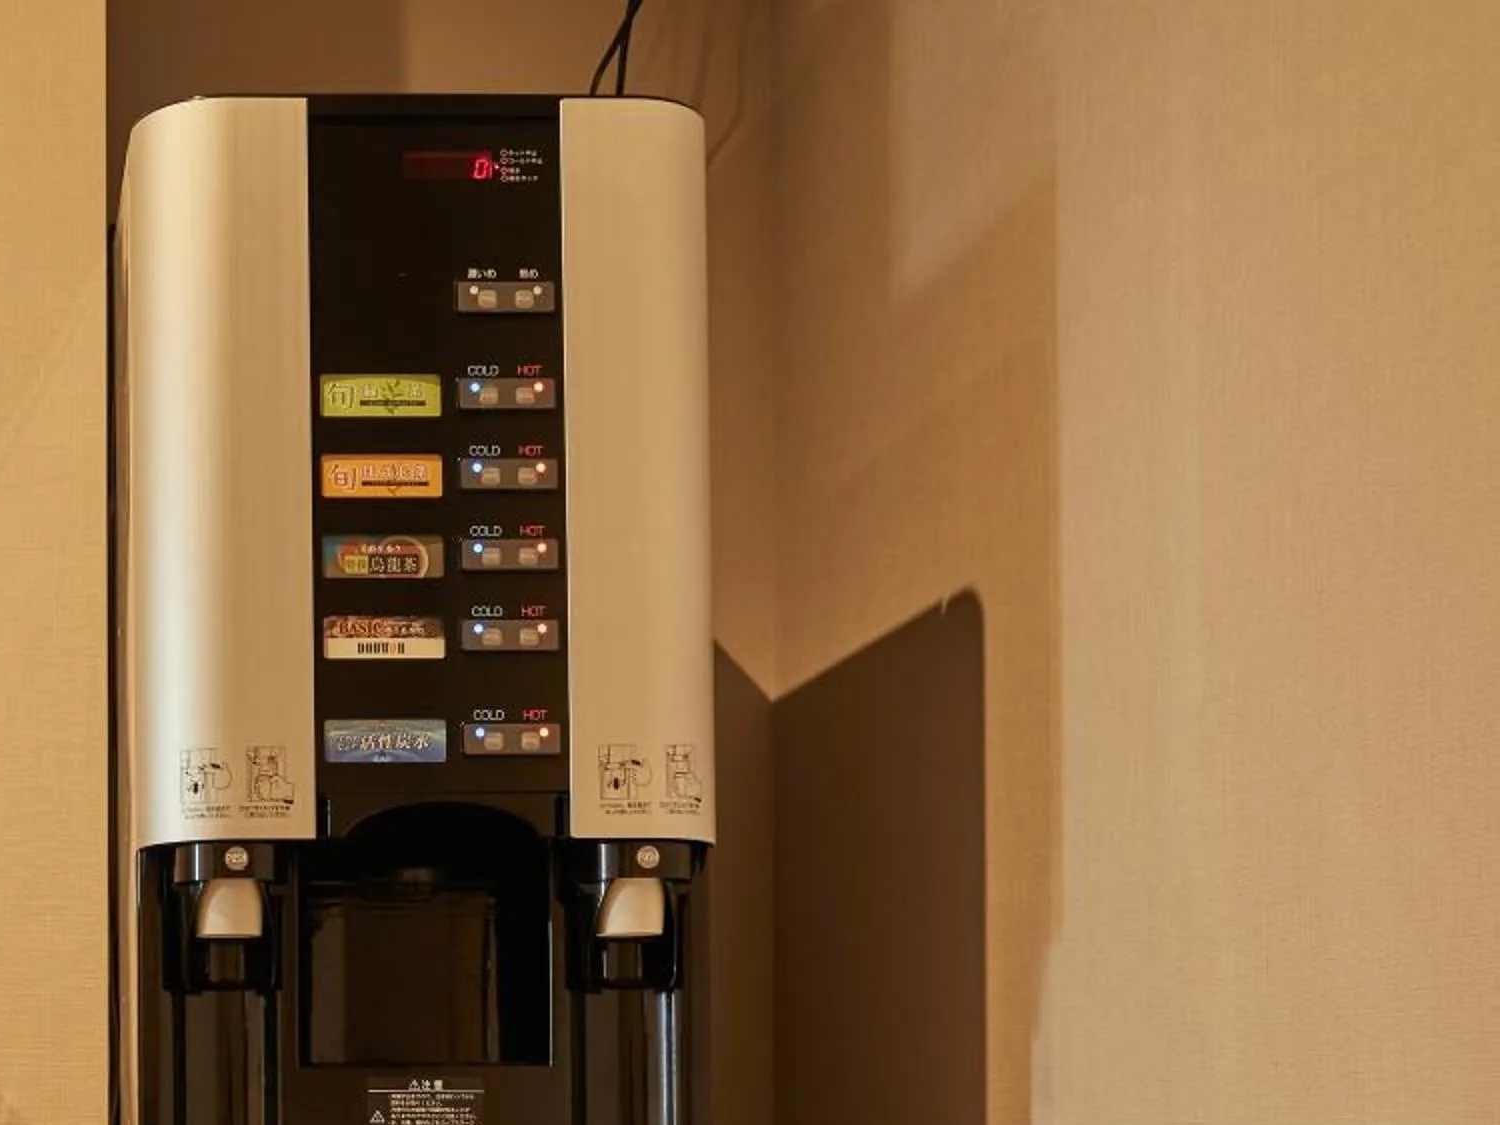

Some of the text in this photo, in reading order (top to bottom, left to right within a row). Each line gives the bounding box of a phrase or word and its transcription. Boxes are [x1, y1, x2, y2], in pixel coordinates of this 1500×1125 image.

[467, 365, 541, 377] COLD HOT
[469, 445, 543, 457] COLD HOT
[469, 525, 545, 537] COLD HOT
[471, 605, 546, 617] COLD HOT
[339, 620, 384, 634] BASIC
[473, 709, 547, 721] COLD HOT
